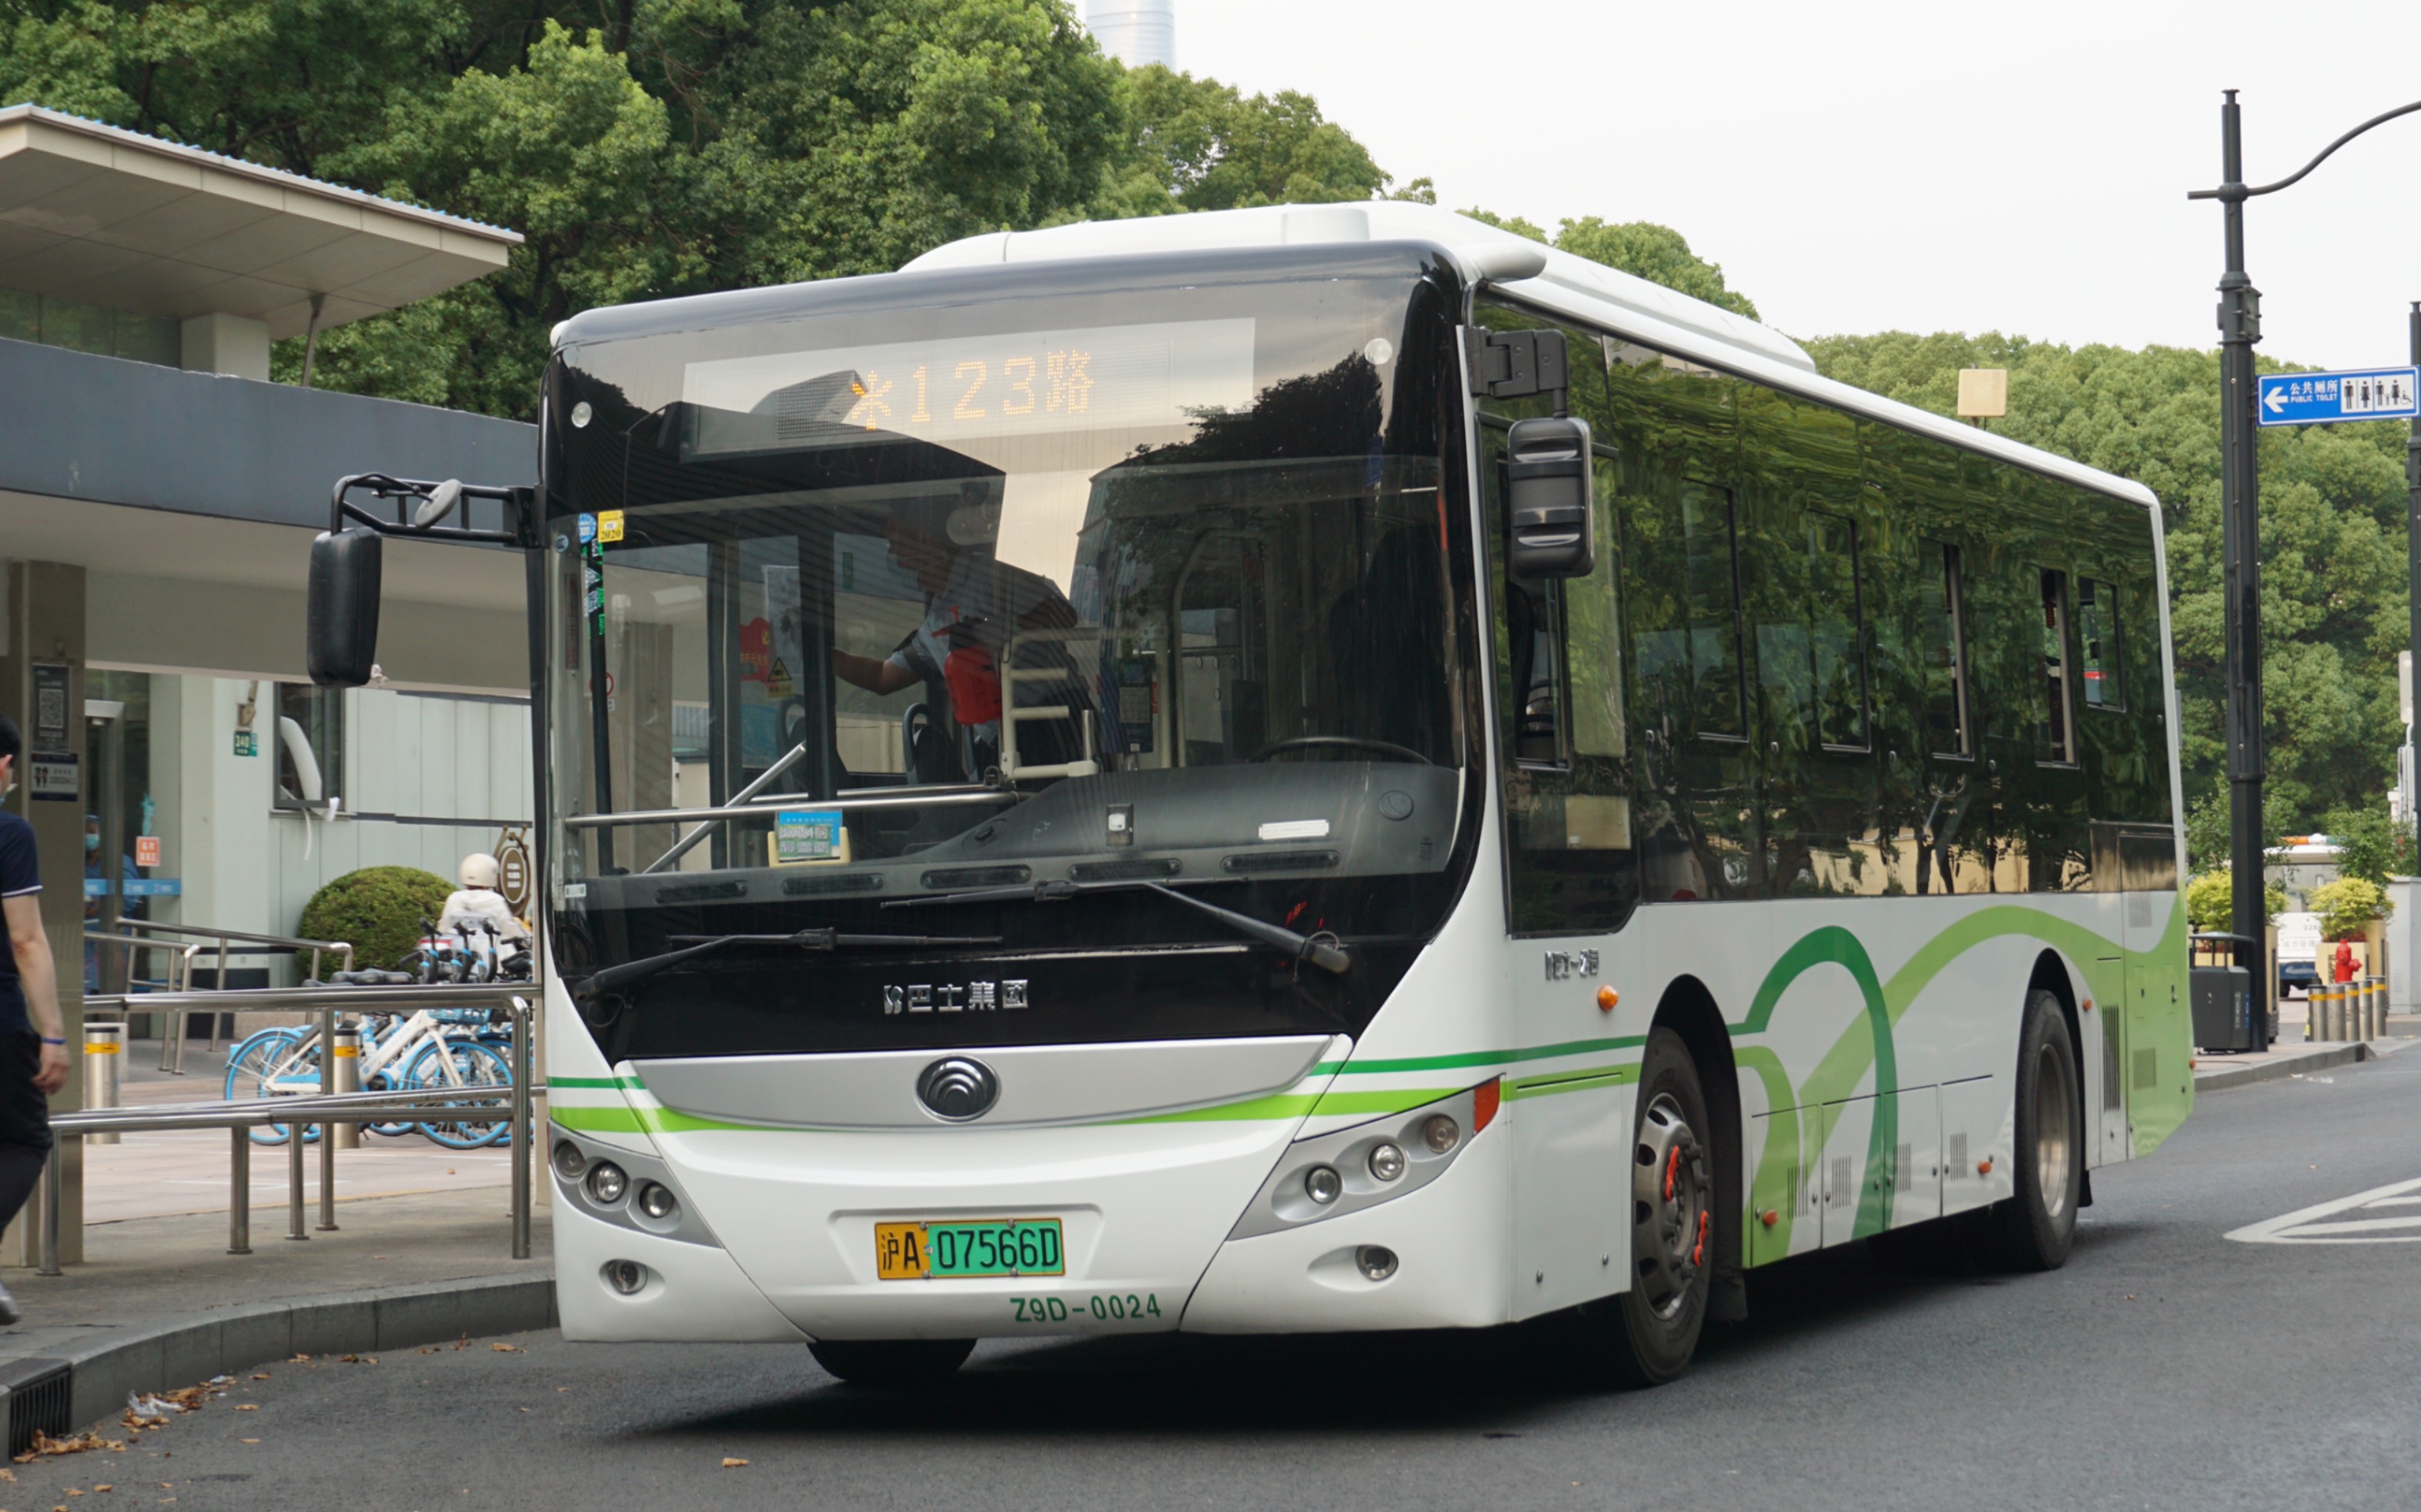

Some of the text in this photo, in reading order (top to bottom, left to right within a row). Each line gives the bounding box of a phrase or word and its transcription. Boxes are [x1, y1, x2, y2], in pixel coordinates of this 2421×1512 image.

[2290, 393, 2337, 403] PUBLIC TOILET
[600, 529, 621, 541] 2020
[881, 1228, 1059, 1271] 沪A 07566D
[1009, 1292, 1162, 1323] Z9D-0024
